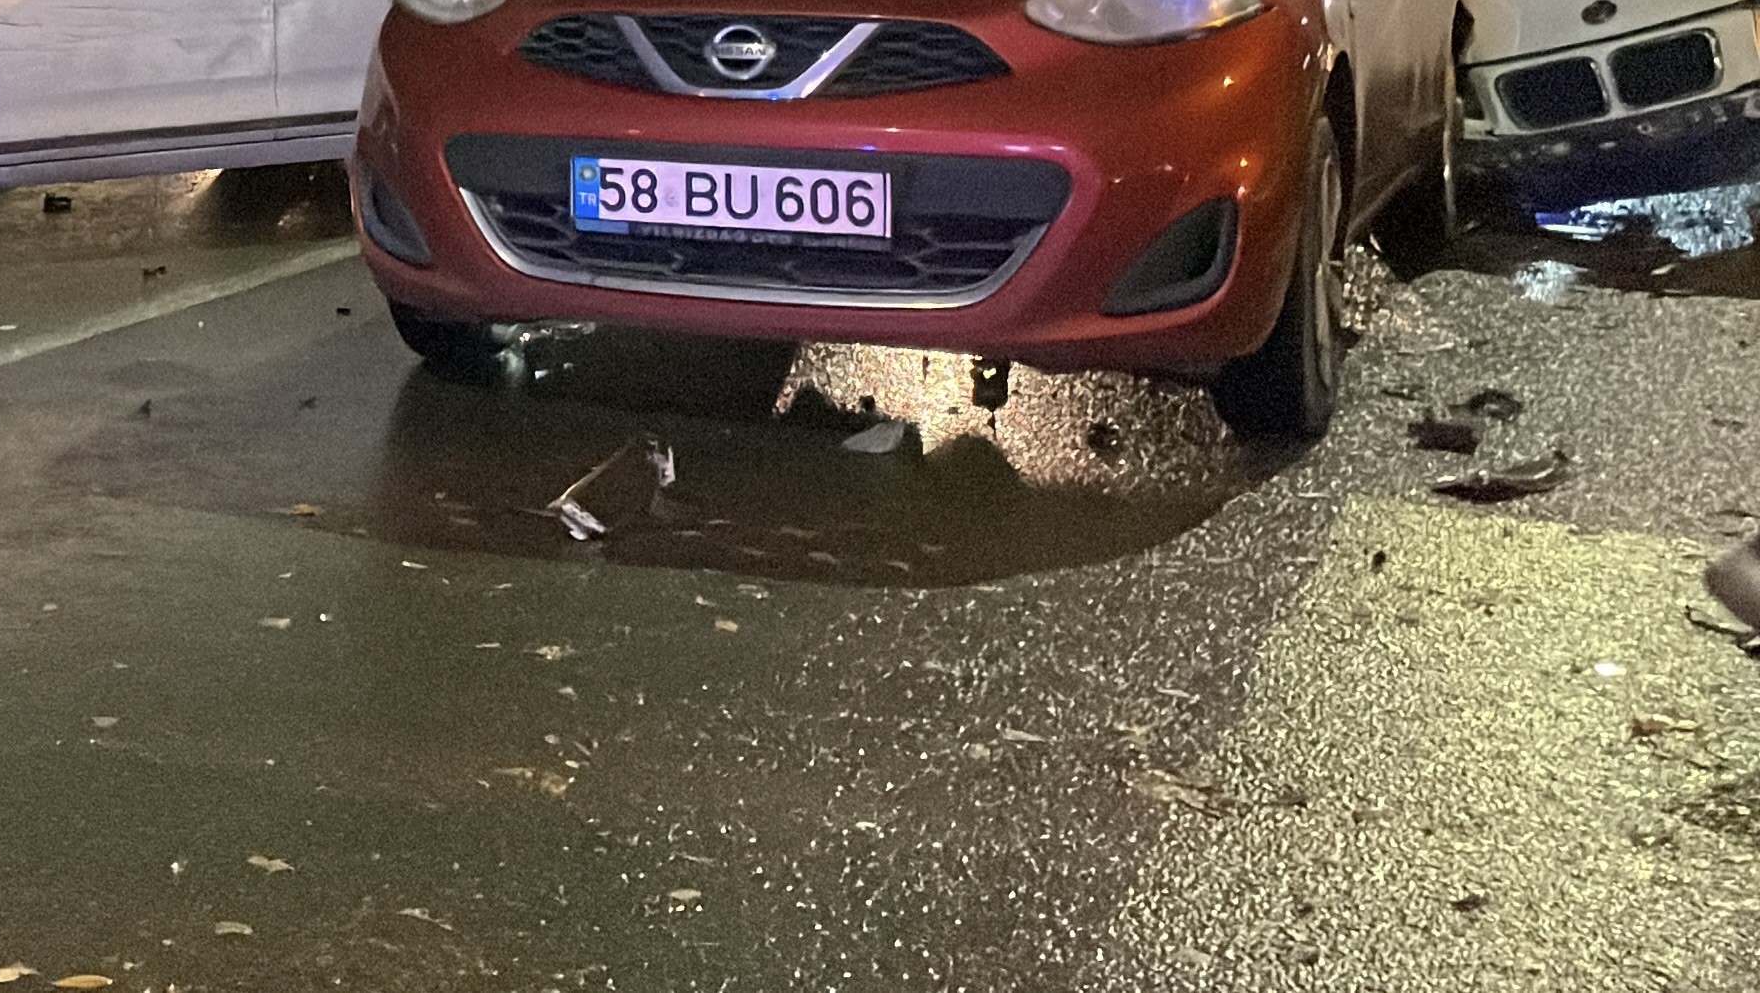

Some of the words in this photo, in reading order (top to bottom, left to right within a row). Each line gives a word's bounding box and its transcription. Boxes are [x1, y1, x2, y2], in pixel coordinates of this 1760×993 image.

[711, 45, 767, 57] NISSAN
[577, 191, 597, 206] TR
[600, 167, 658, 214] 58
[685, 171, 759, 220] BU
[775, 176, 875, 227] 606
